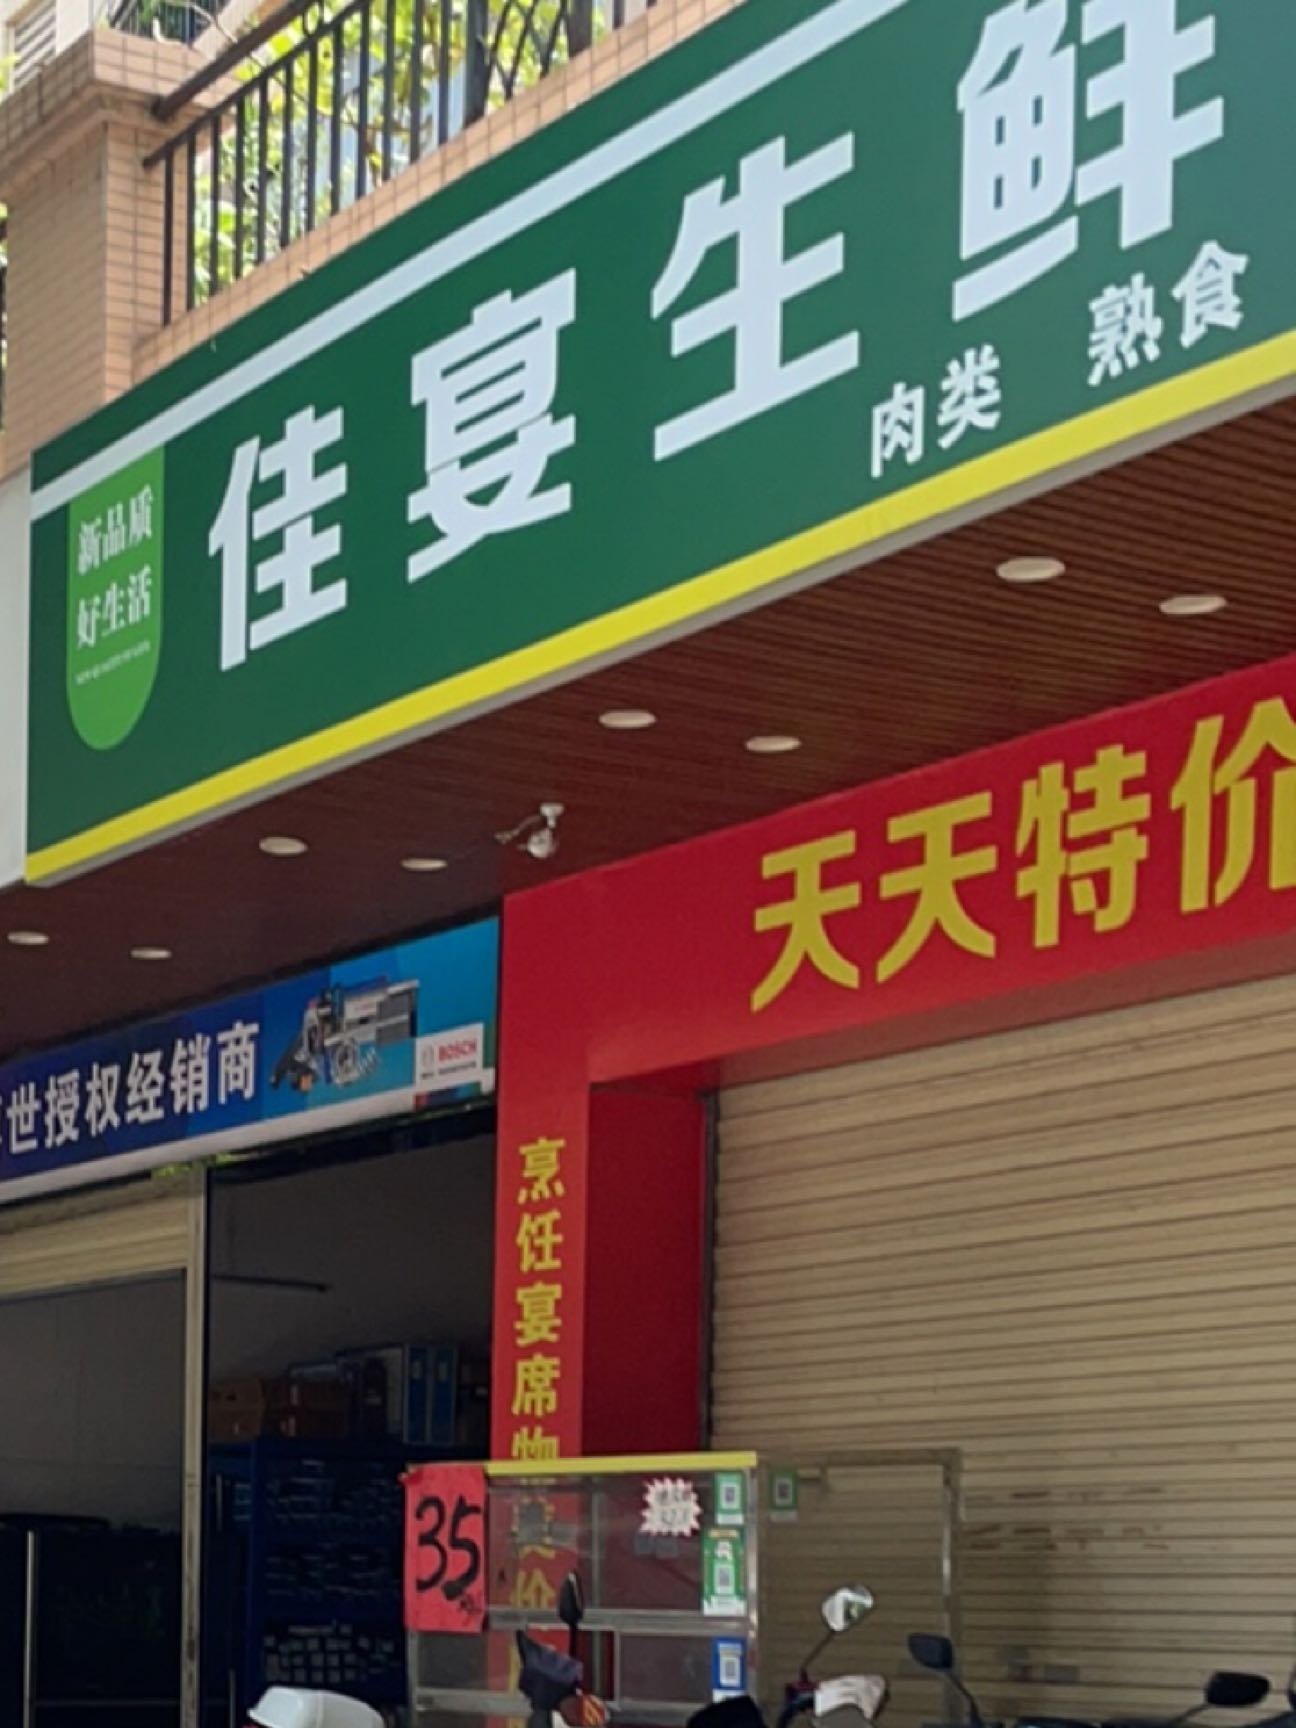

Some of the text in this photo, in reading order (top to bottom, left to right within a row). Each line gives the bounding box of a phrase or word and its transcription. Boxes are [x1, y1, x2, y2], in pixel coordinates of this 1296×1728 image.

[207, 0, 1224, 671] 佳宴生鲜
[870, 240, 1249, 478] 肉类 熟食
[76, 563, 152, 649] 好生活
[750, 697, 1296, 1014] 天天特价
[415, 1495, 482, 1601] 35
